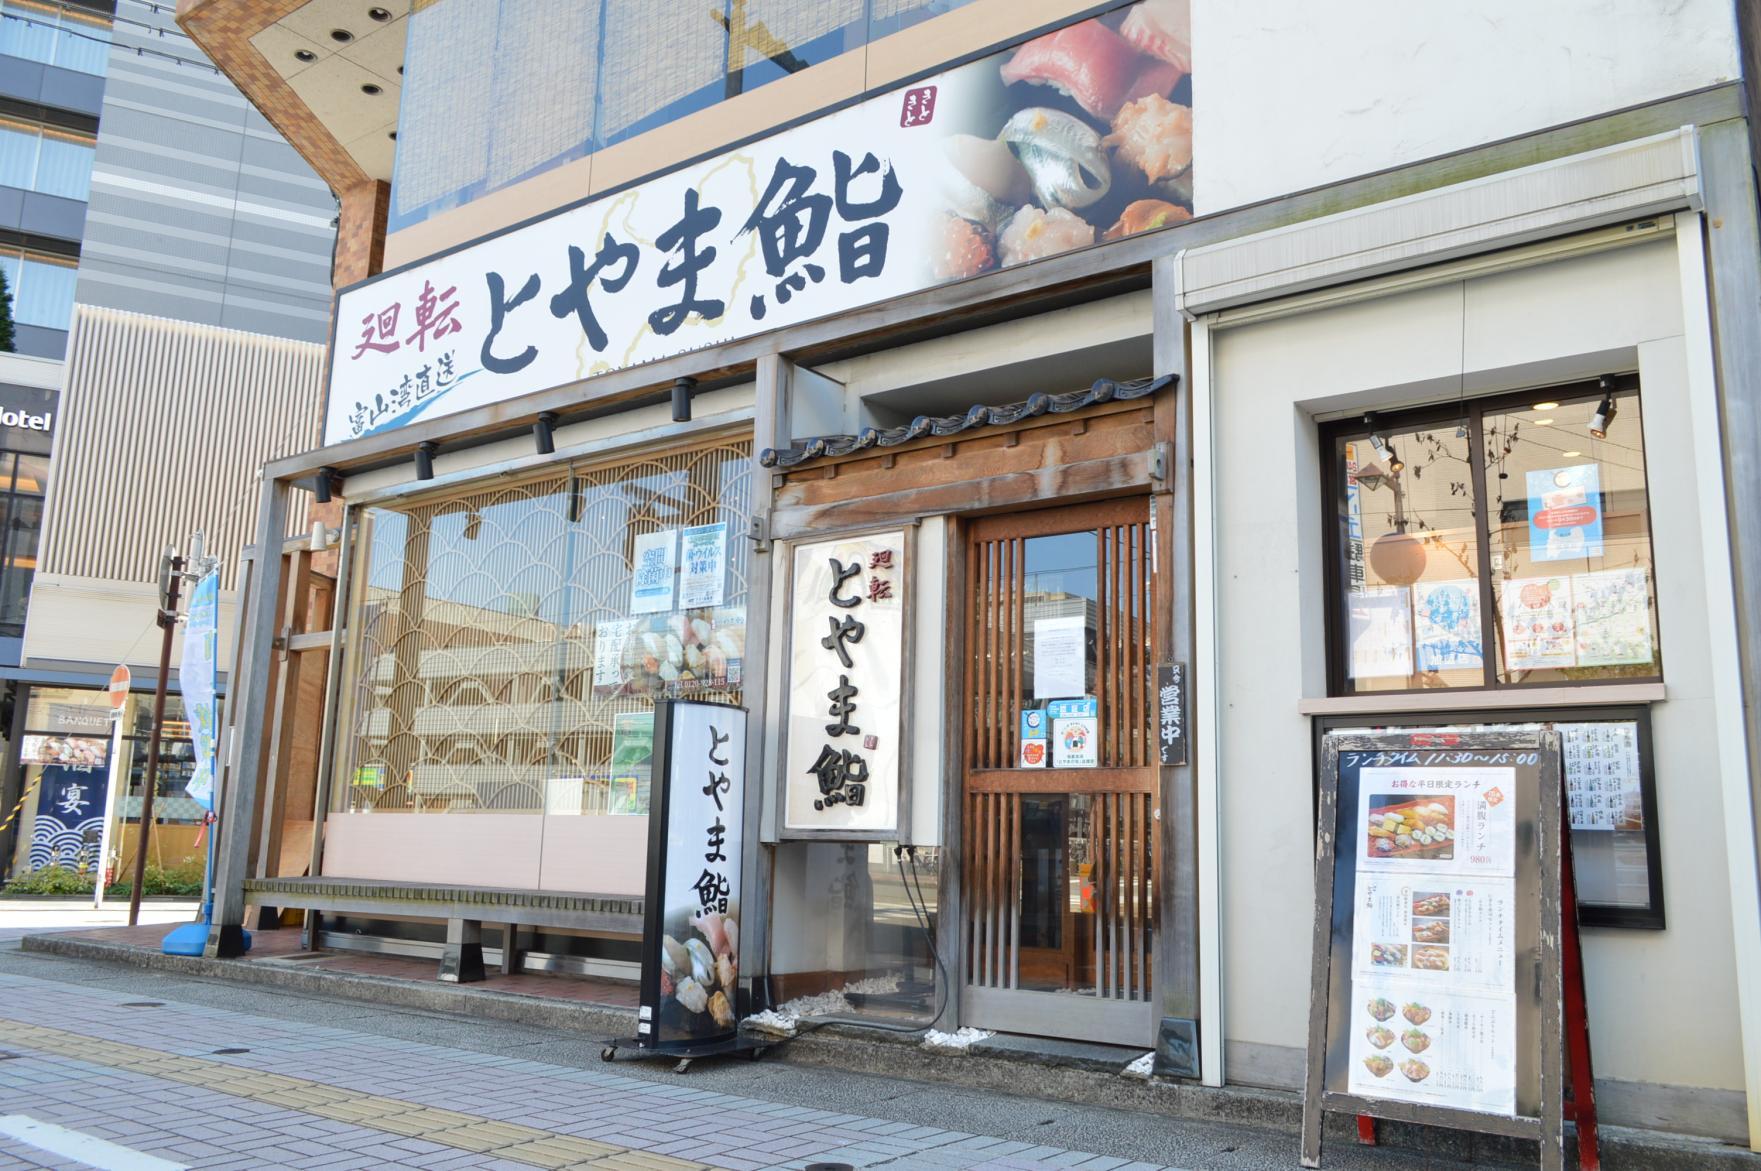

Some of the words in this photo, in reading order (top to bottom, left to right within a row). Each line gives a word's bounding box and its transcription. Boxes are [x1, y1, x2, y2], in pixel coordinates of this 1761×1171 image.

[480, 150, 904, 374] とやま鮨
[351, 280, 462, 361] 廻転
[349, 349, 455, 435] 富山湾直送
[867, 550, 893, 603] 廻転
[58, 714, 109, 727] BANQUET
[806, 558, 870, 812] とやま鮨
[1159, 684, 1181, 745] 営業中
[689, 725, 731, 919] とやま鮨
[1391, 779, 1481, 789] お得な平日限定ランチ
